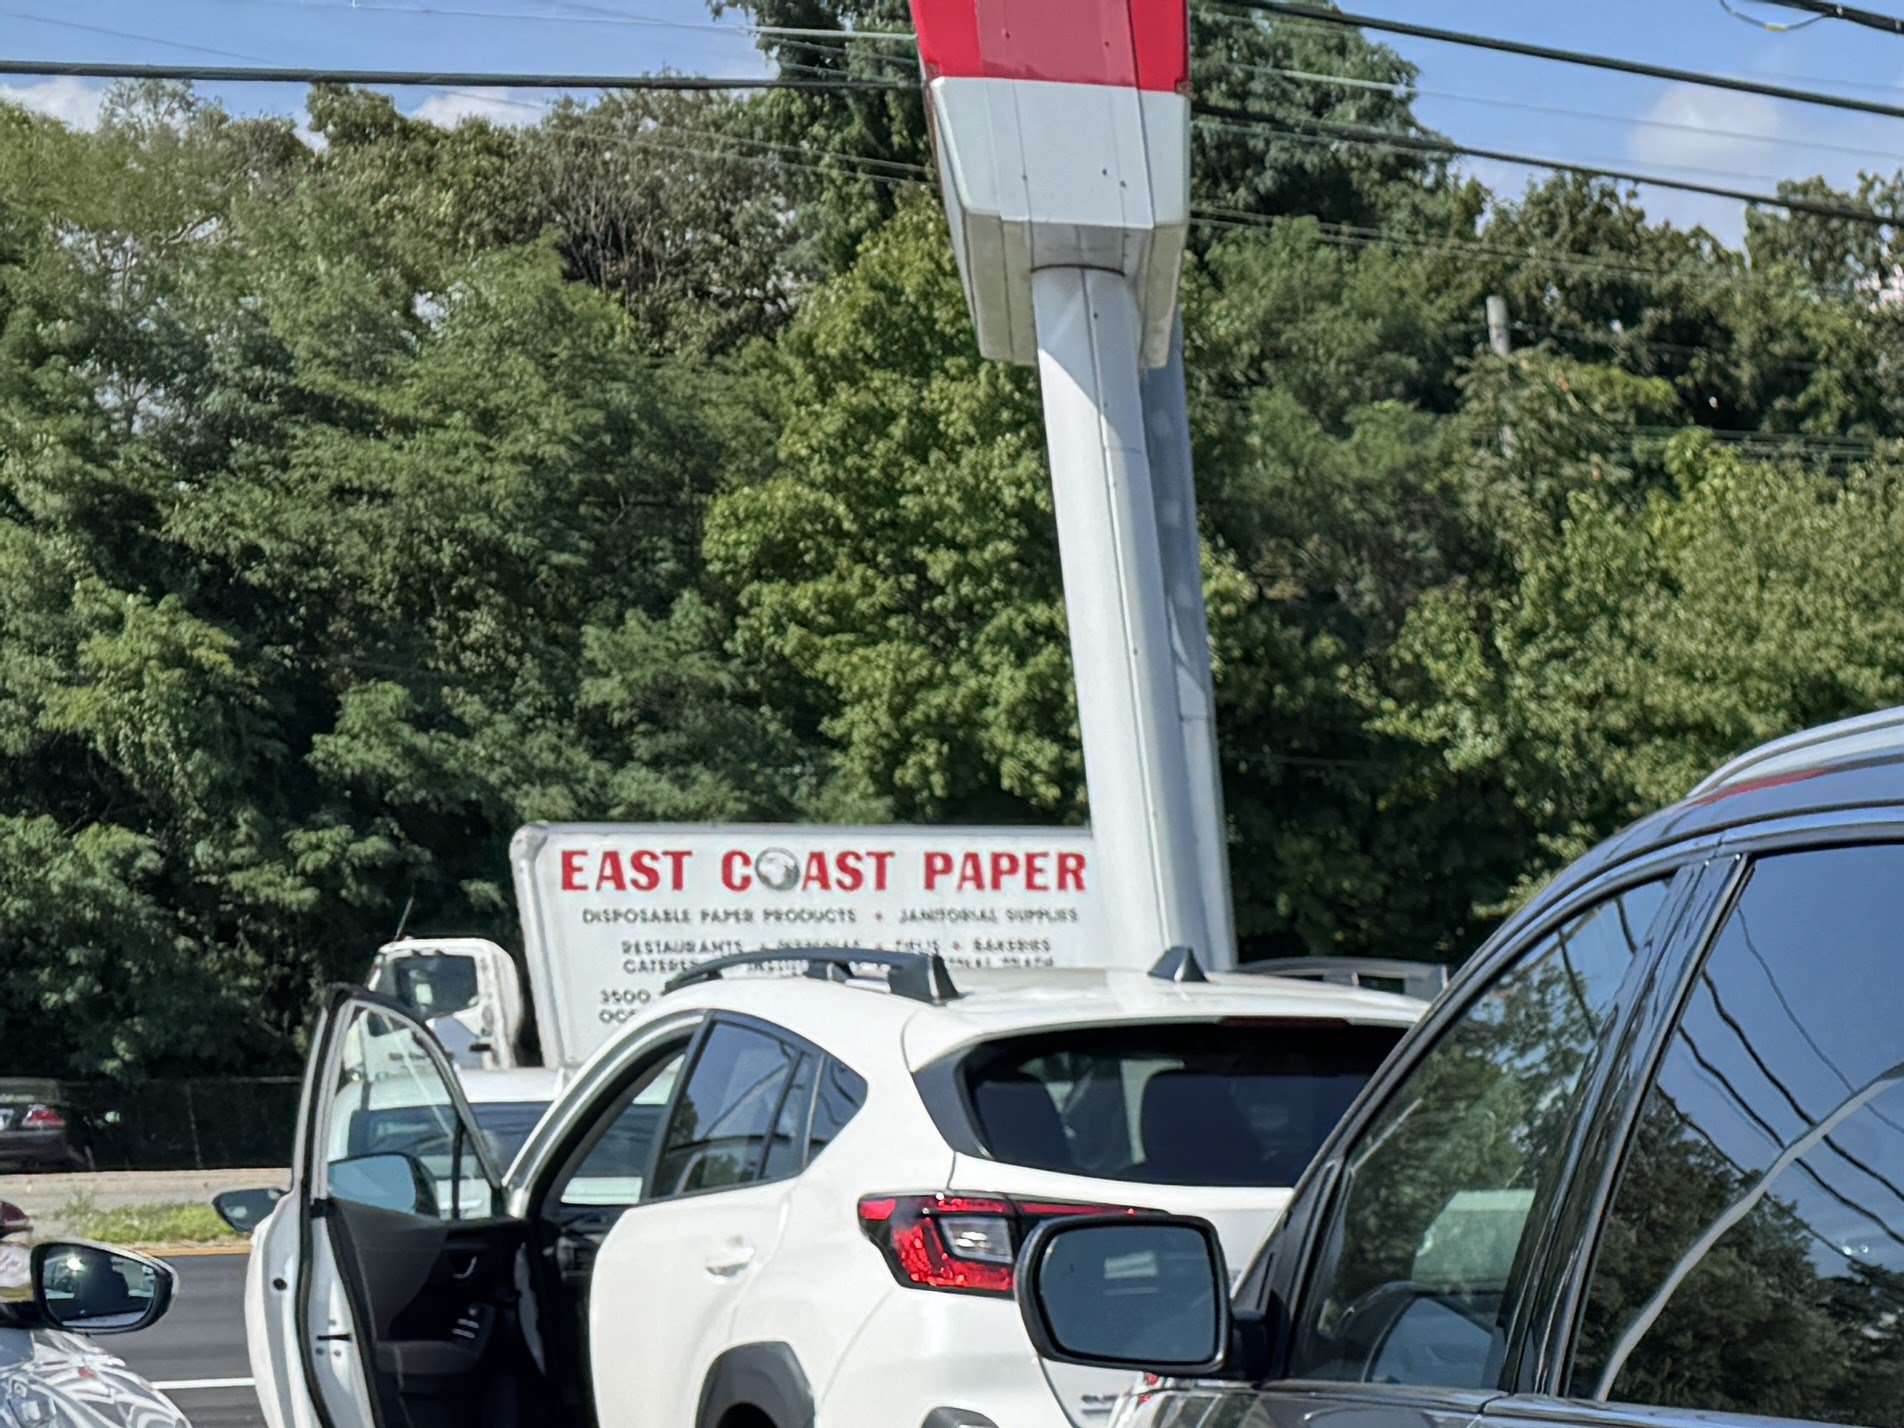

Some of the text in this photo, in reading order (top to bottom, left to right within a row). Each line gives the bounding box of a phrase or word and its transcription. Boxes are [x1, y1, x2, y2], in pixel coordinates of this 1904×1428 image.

[560, 849, 693, 891] EAST
[923, 852, 1087, 891] PAPER
[583, 908, 1079, 924] DISPOSABLE PAPER PRODUCTS JANITORIAL SUPPLIES
